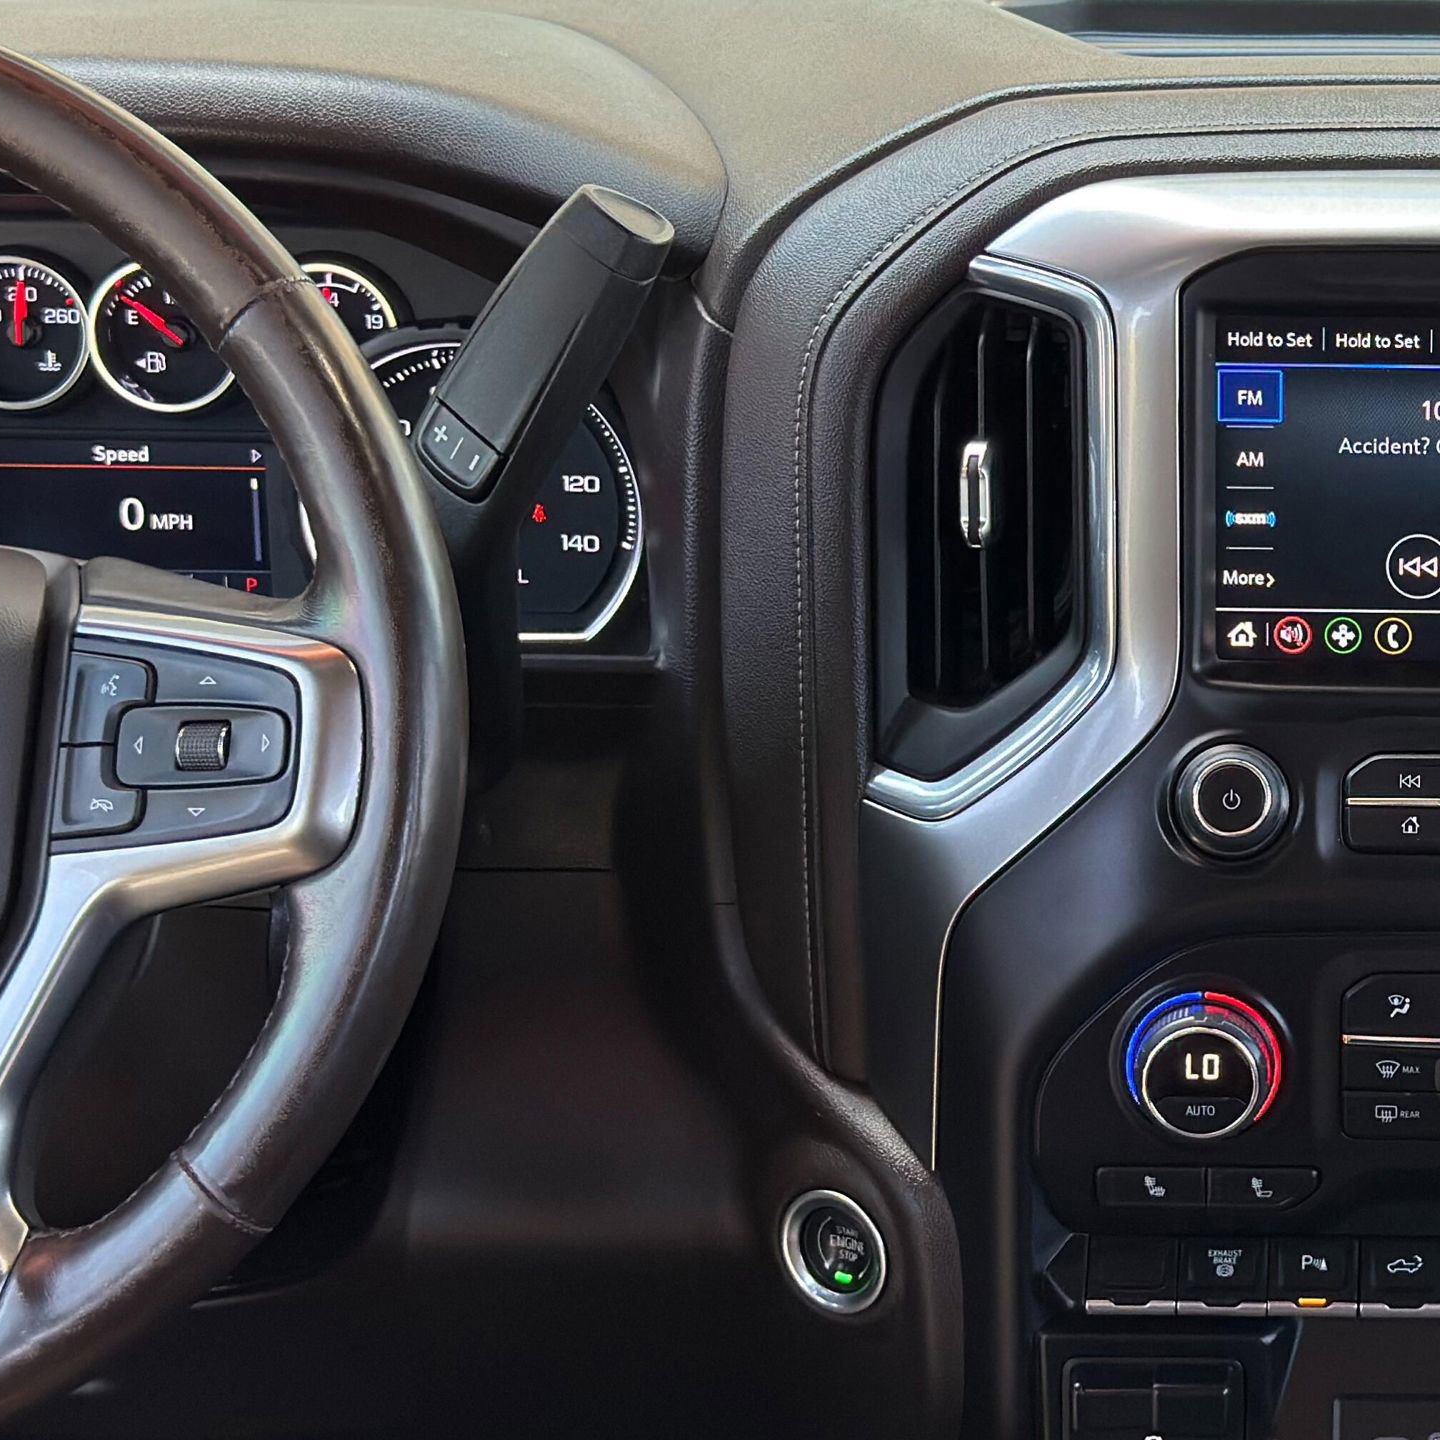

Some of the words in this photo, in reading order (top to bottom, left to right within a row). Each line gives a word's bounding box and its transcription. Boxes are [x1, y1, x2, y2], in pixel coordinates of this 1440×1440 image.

[6, 286, 38, 302] 20
[328, 292, 340, 308] 4
[44, 307, 81, 324] 260
[127, 310, 140, 326] E
[364, 313, 385, 330] 19
[1227, 331, 1263, 347] Hold
[1266, 333, 1284, 347] to
[1286, 332, 1313, 348] Set
[1335, 332, 1371, 349] Hold
[1374, 334, 1392, 349] to
[1394, 333, 1421, 349] Set
[1237, 389, 1263, 406] FM
[1338, 436, 1431, 455] Accident?
[91, 445, 150, 465] Speed
[1236, 451, 1264, 467] AM
[562, 474, 601, 494] 120
[119, 497, 146, 531] 0
[150, 513, 193, 531] MPH
[560, 533, 601, 553] 140
[244, 576, 258, 592] P
[1222, 569, 1265, 586] More
[1185, 1053, 1220, 1081] LO
[1402, 1064, 1421, 1075] MAX
[1185, 1104, 1217, 1117] AUTO
[1399, 1109, 1421, 1120] REAR
[828, 1234, 865, 1256] ENGINE
[839, 1248, 858, 1262] STOP
[1207, 1249, 1243, 1259] EXHAUST
[1213, 1257, 1237, 1265] BRAKE
